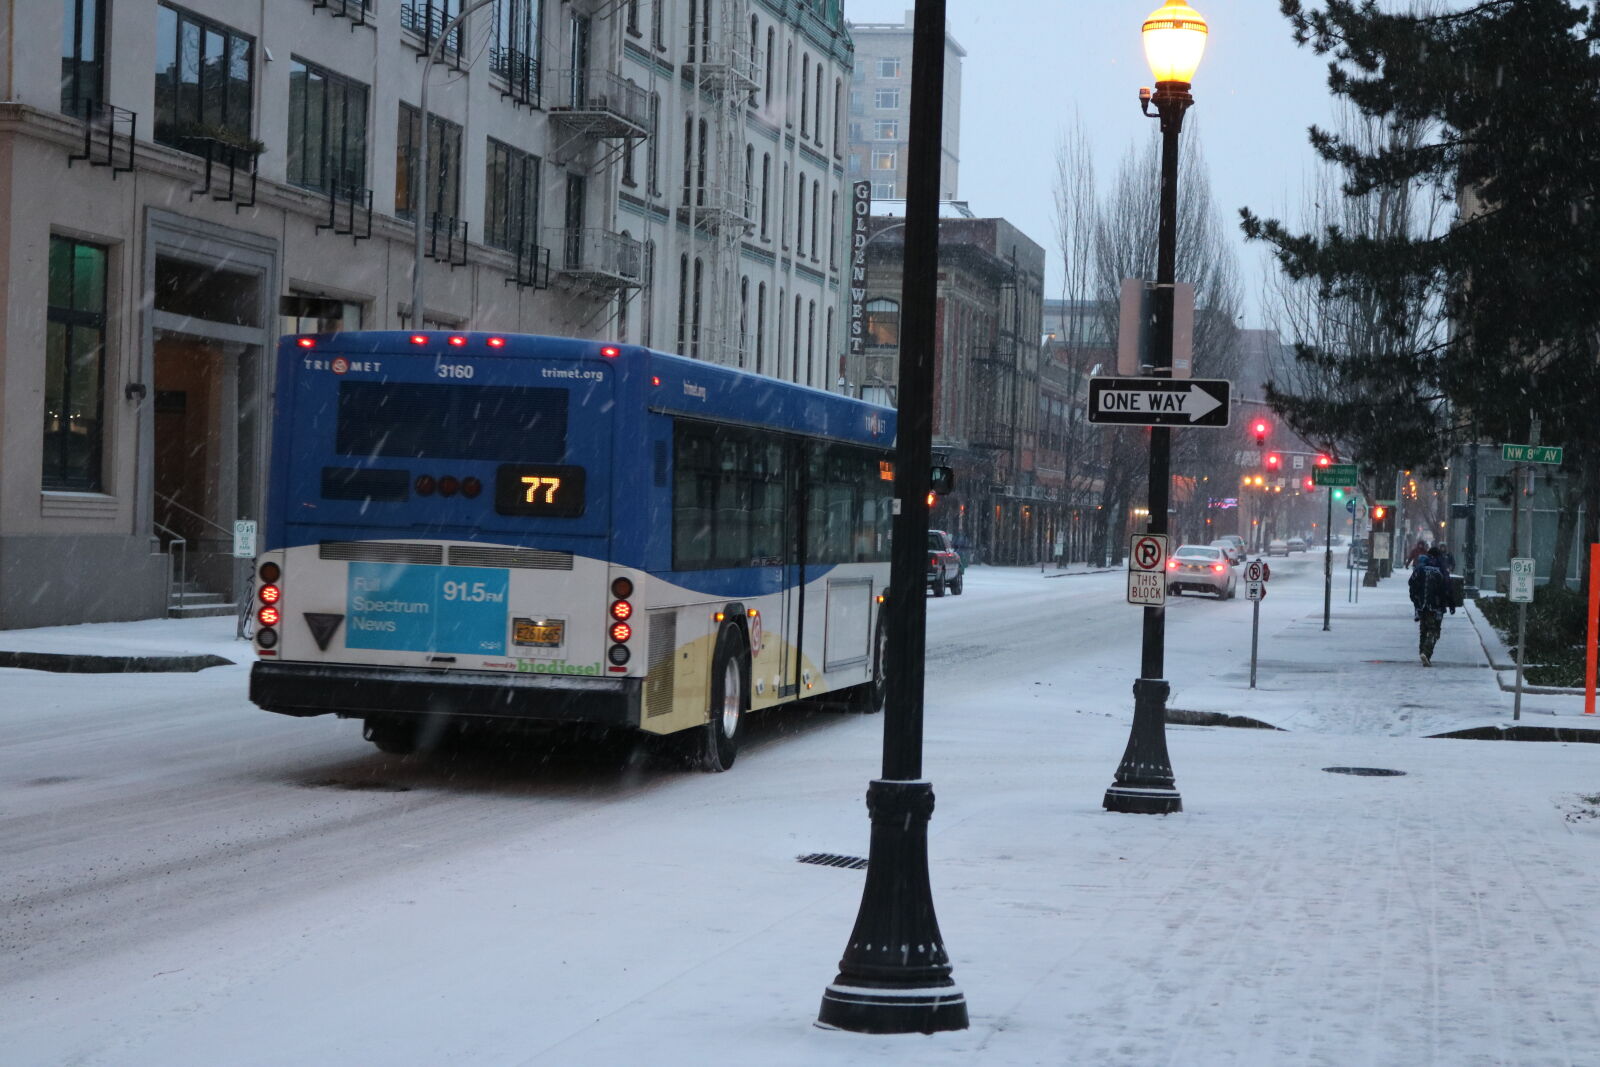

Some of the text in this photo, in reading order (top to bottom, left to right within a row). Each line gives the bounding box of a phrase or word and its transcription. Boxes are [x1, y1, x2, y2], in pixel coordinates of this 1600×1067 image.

[852, 184, 869, 351] GOLDEN WEST
[438, 365, 474, 379] 3160
[542, 367, 604, 382] trimet.org
[1103, 392, 1187, 412] ONE WAY
[1507, 447, 1523, 459] NW
[1544, 450, 1557, 461] AV
[521, 476, 560, 503] 77
[354, 576, 380, 591] Full
[1136, 574, 1158, 586] THIS
[1132, 586, 1161, 599] BLOCK
[352, 596, 429, 614] Spectrum
[352, 616, 396, 632] News
[516, 657, 601, 675] biodiesel
